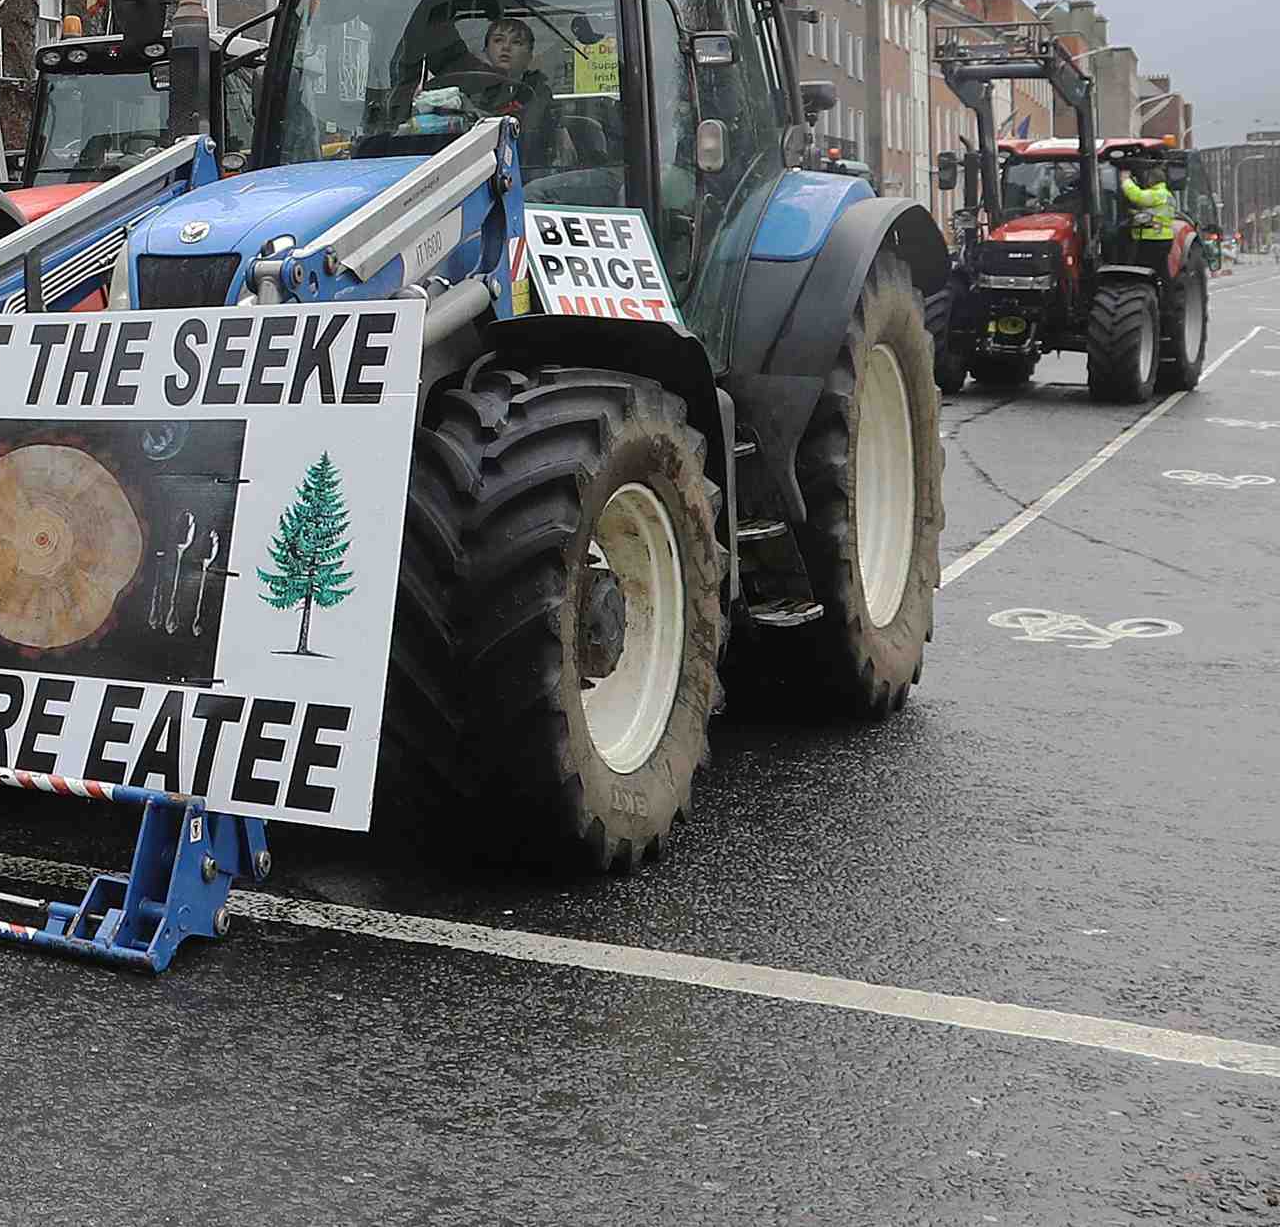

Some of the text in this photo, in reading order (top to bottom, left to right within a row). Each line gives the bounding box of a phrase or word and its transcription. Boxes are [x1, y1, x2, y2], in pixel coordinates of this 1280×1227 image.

[533, 214, 633, 249] BEEF
[538, 254, 662, 290] PRICE
[558, 295, 666, 321] MUST
[25, 322, 153, 406] THE
[163, 312, 397, 407] SEEKE
[83, 684, 352, 813] EATEE
